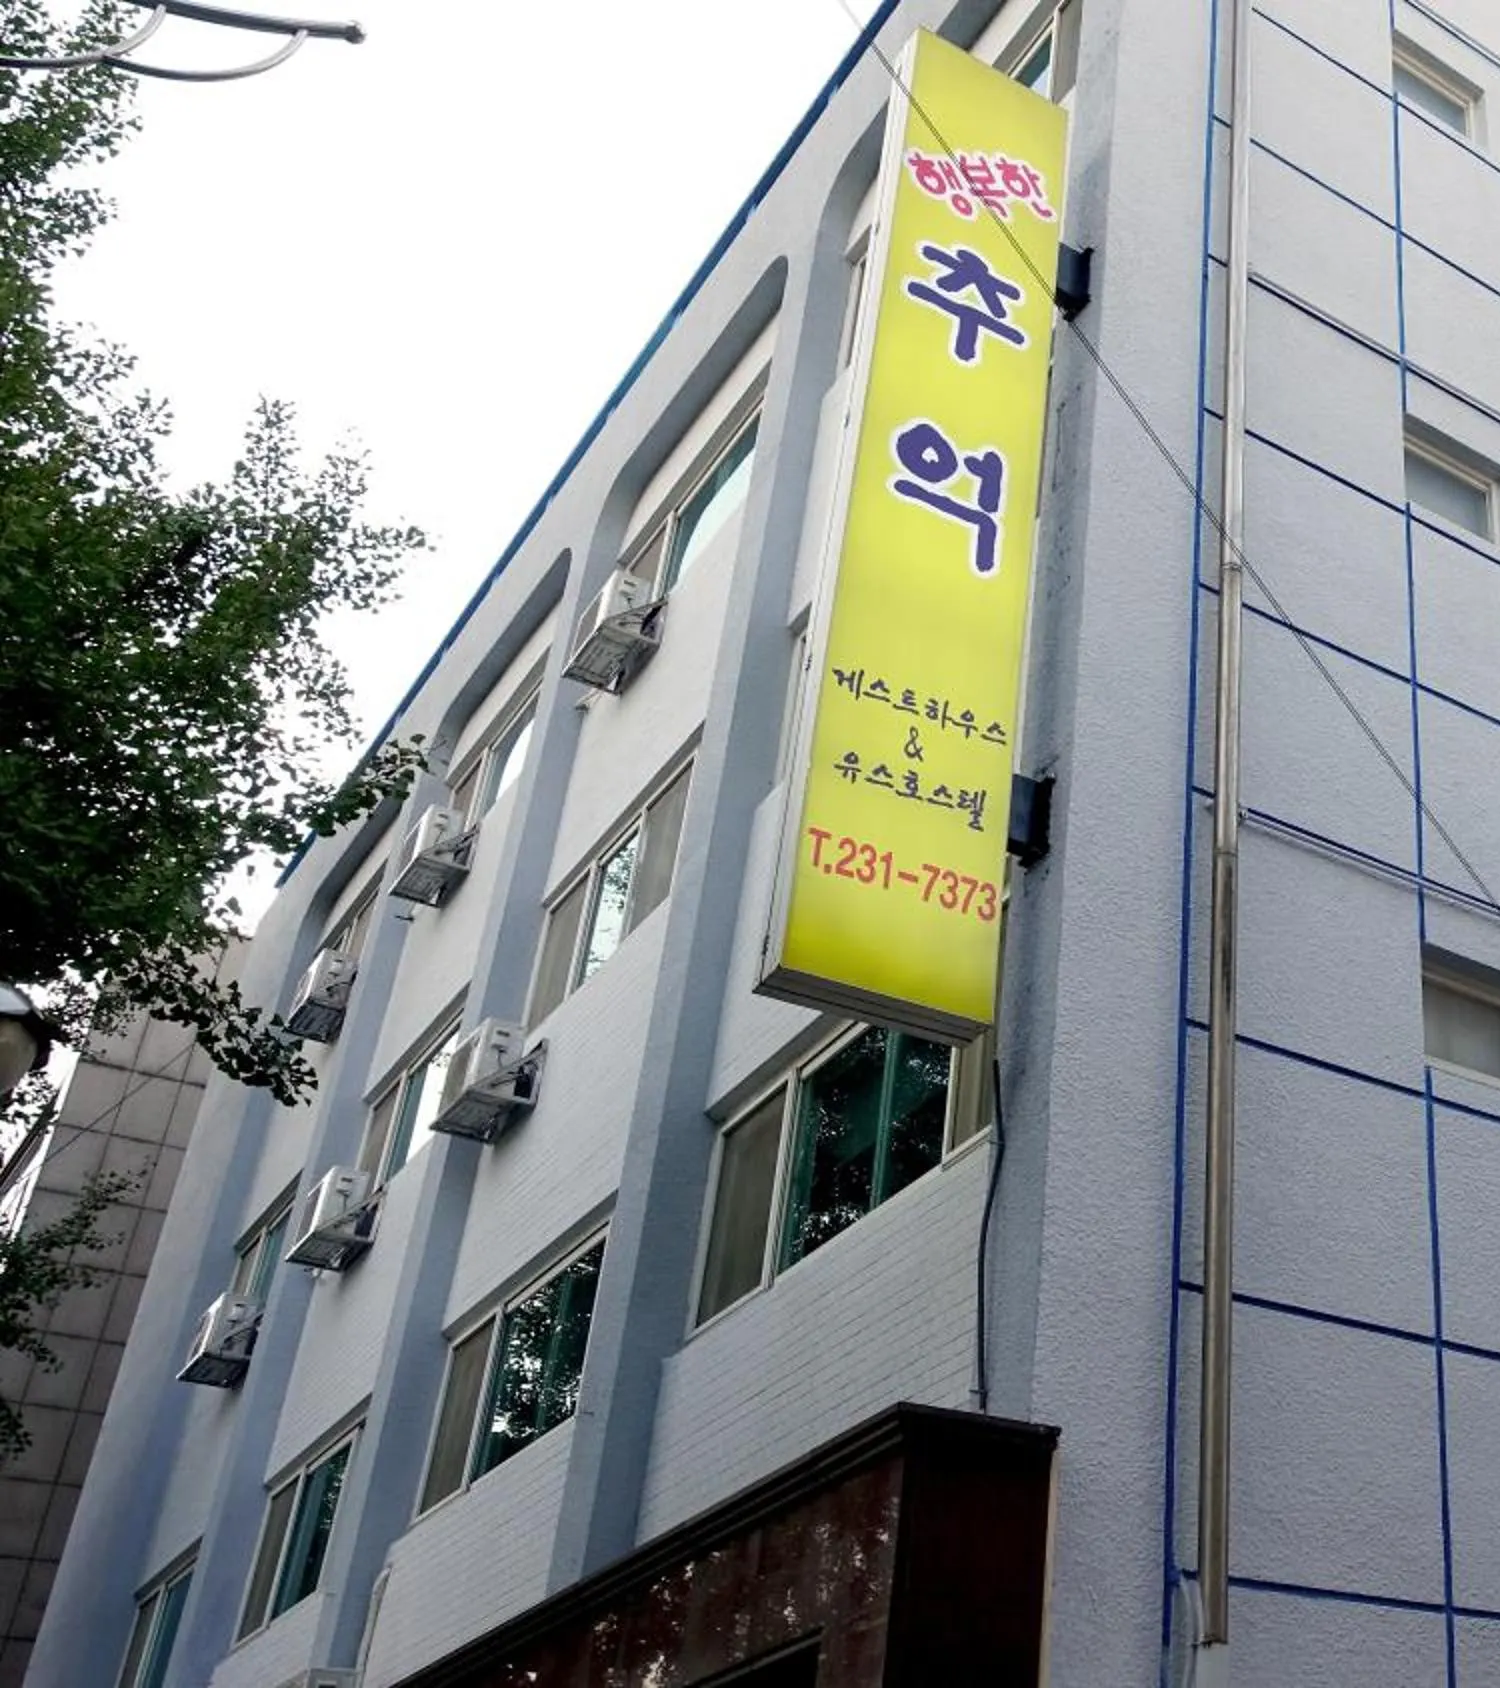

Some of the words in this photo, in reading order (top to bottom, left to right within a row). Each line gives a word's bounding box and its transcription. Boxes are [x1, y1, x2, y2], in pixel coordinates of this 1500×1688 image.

[908, 153, 1053, 218] 행복한
[894, 245, 1026, 572] 추억
[832, 668, 1007, 745] 게스트하우스
[904, 727, 924, 762] &
[834, 750, 986, 832] 유스호스텔
[808, 827, 997, 922] T.231-7373
